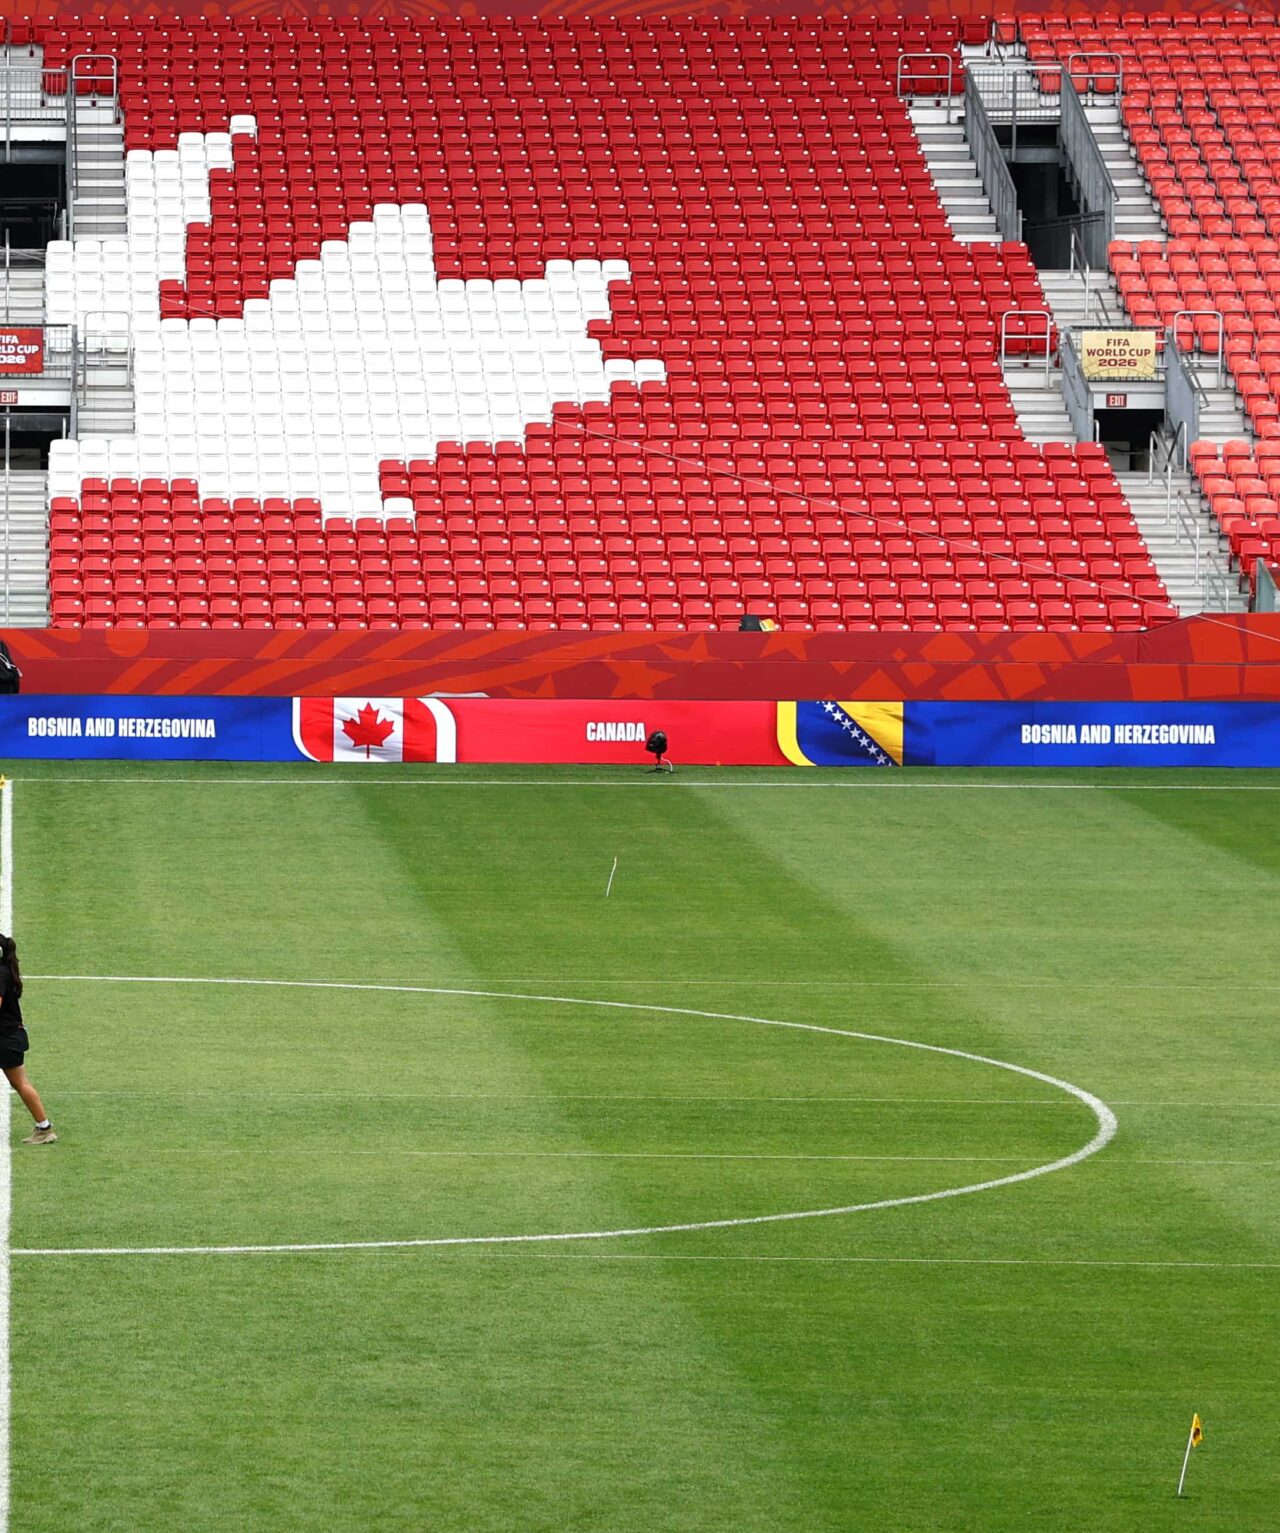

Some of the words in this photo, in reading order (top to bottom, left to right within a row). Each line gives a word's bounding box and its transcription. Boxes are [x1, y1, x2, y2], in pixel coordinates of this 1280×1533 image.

[1106, 338, 1130, 347] FIFA
[16, 345, 39, 354] CUP
[1086, 348, 1127, 357] WORLD
[1129, 348, 1151, 357] CUP
[1098, 358, 1137, 367] 2026
[0, 392, 17, 403] EXIT
[1109, 395, 1125, 406] EXIT
[27, 717, 82, 737] BOSNIA
[85, 717, 115, 737] AND
[118, 717, 216, 738] HERZEGOVINA
[586, 721, 646, 742] CANADA
[1021, 724, 1077, 744] BOSNIA
[1079, 724, 1112, 744] AND
[1114, 724, 1216, 745] HERZEGOVINA
